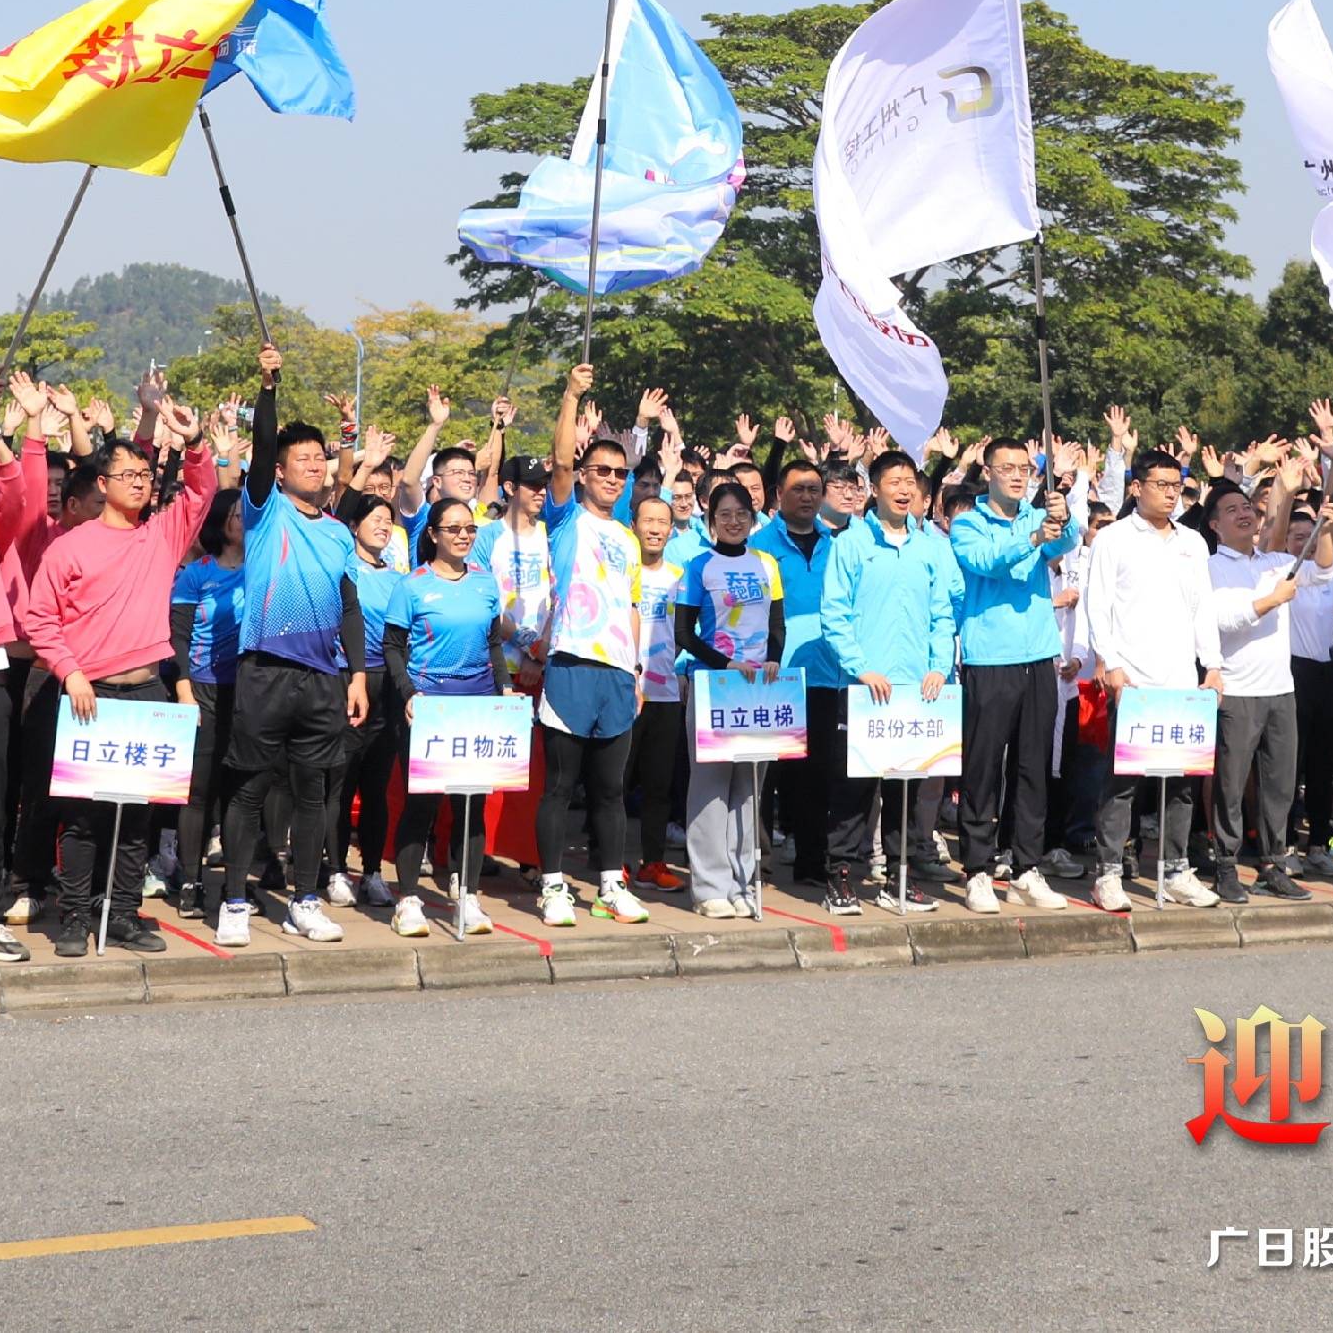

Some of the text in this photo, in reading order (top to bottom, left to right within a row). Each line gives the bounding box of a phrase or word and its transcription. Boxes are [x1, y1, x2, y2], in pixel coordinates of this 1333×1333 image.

[711, 704, 794, 729] 日立电梯
[867, 719, 944, 739] 股份本部
[1128, 724, 1206, 744] 广日电梯
[71, 740, 176, 768] 日立楼宇
[425, 735, 519, 759] 广日物流
